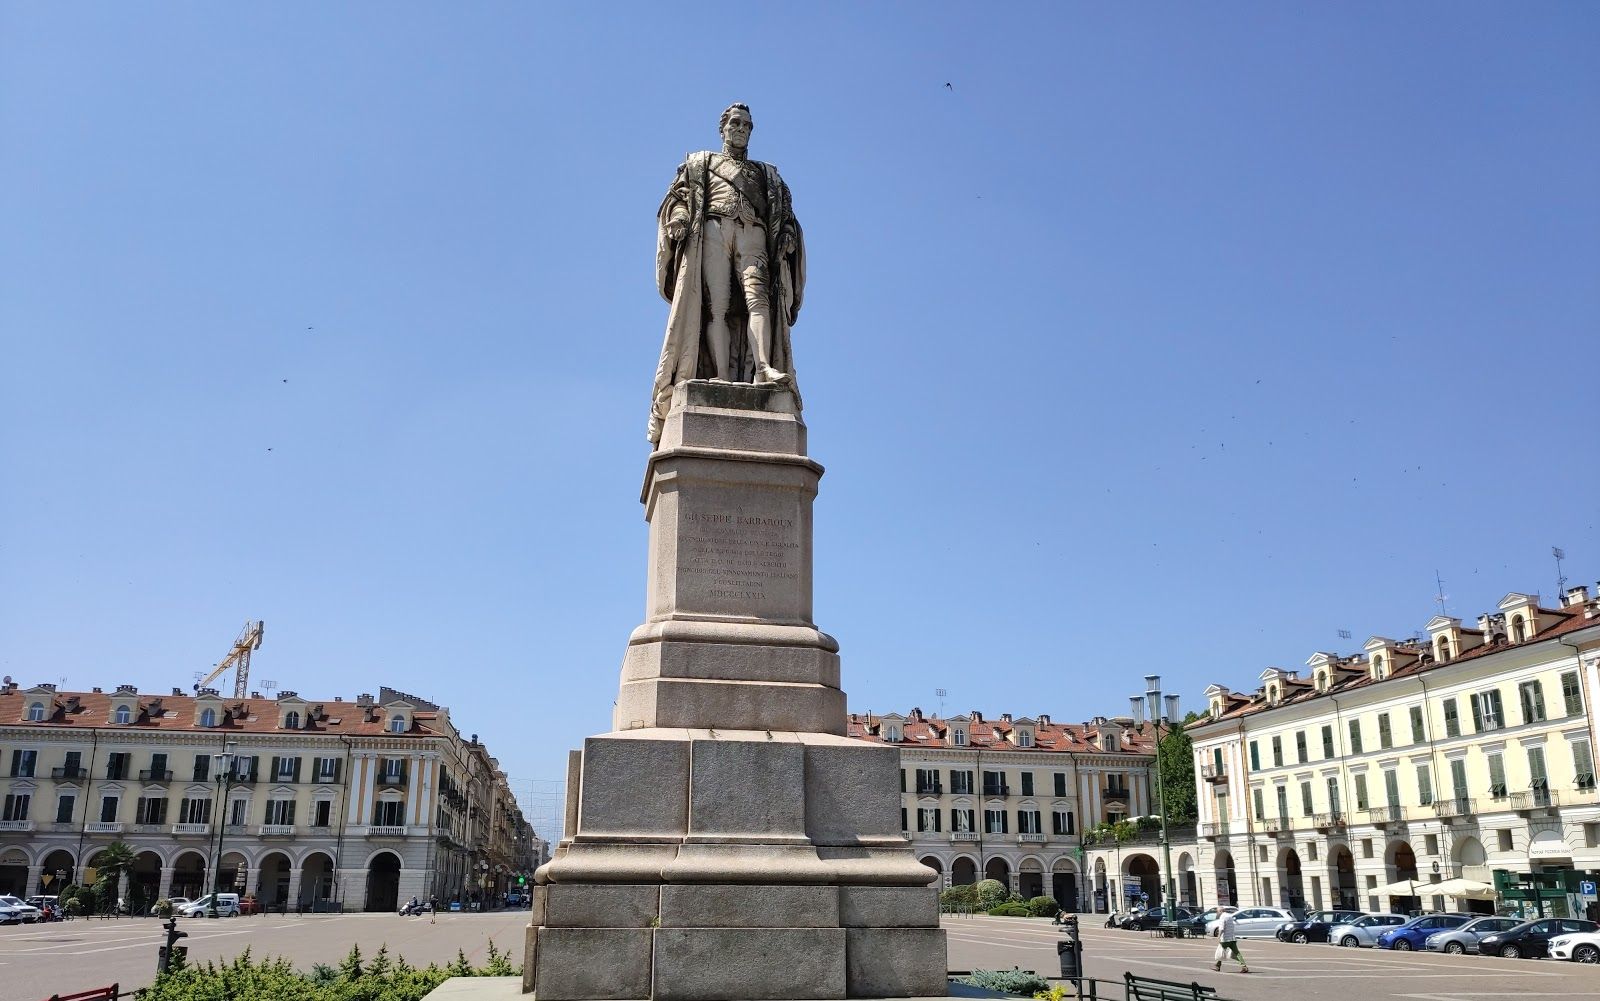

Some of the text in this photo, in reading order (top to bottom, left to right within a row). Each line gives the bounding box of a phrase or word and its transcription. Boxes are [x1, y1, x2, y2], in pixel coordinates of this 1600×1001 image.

[684, 513, 793, 528] GIUSEPPE BARBAROUX
[1583, 883, 1593, 894] P
